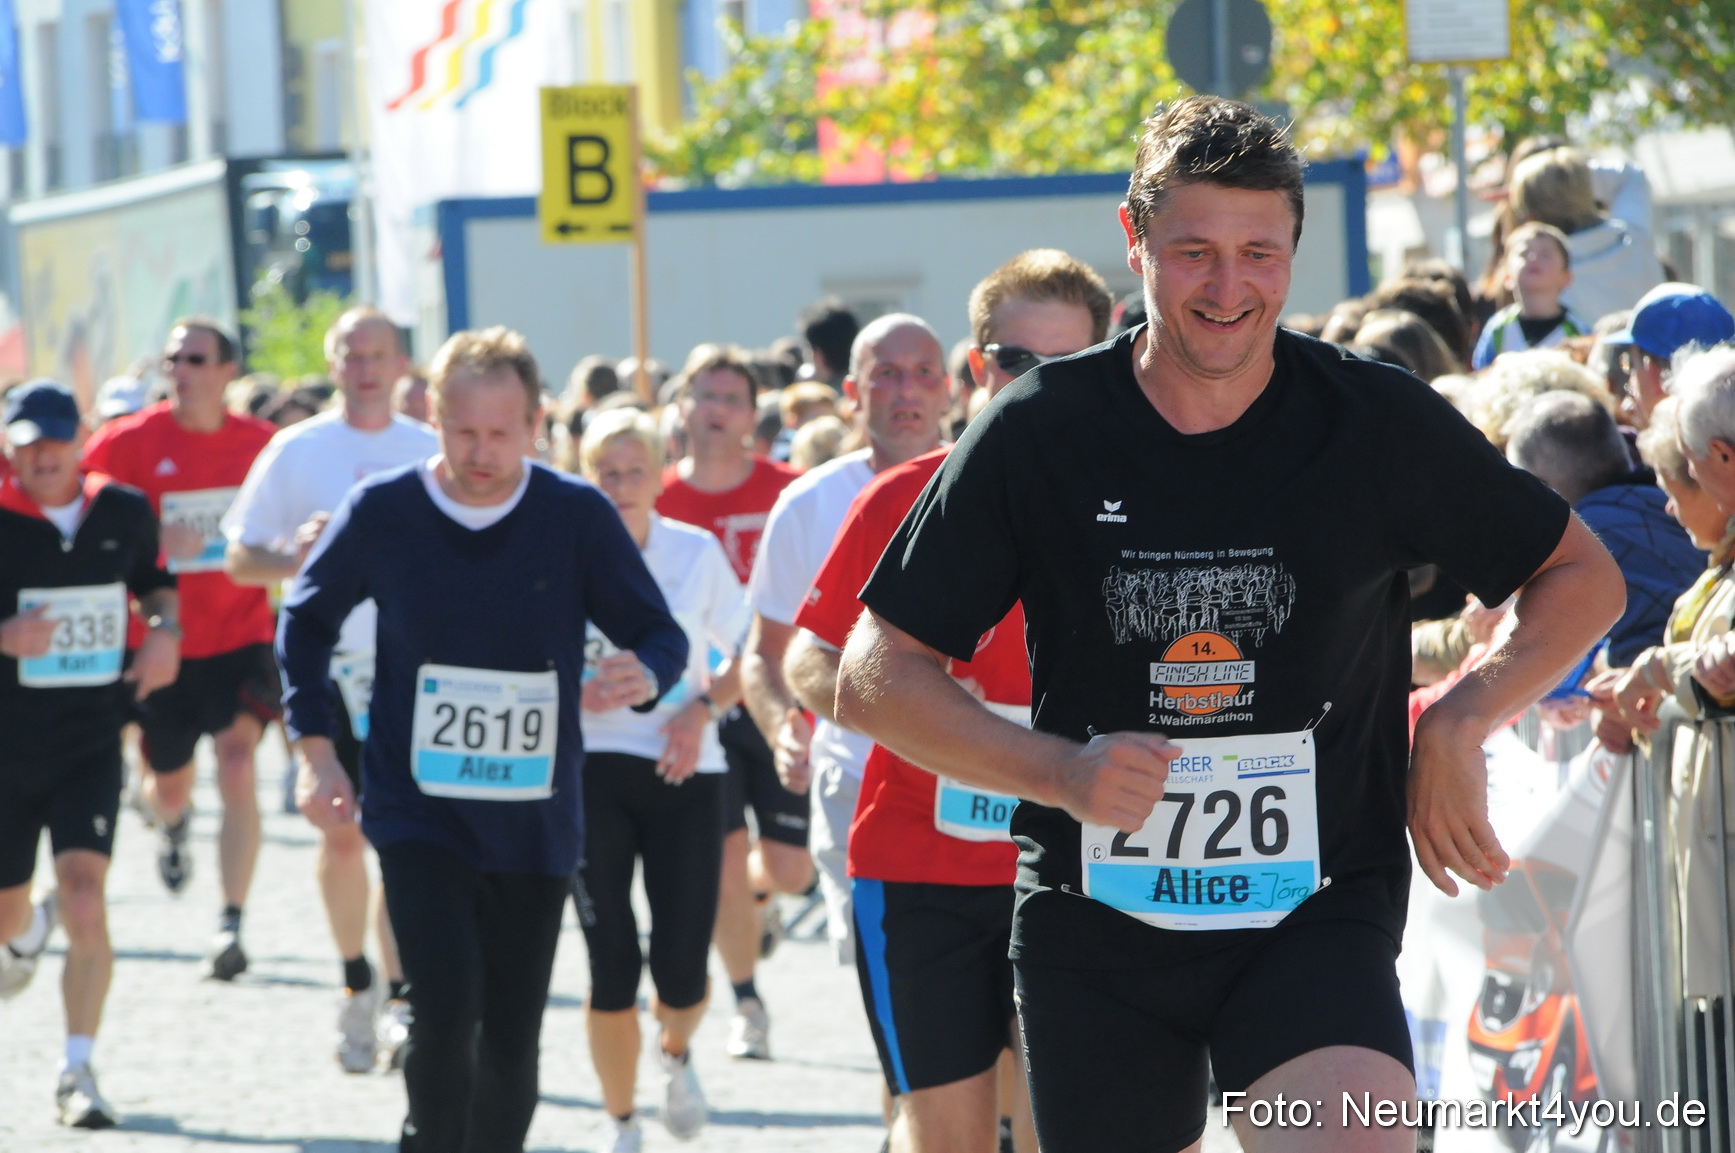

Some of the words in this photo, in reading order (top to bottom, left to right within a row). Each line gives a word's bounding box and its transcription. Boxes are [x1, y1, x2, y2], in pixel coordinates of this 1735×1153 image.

[568, 135, 615, 205] B
[1096, 512, 1128, 523] erima
[1121, 549, 1136, 559] Wir
[1138, 549, 1172, 561] bringen
[1174, 550, 1214, 561] Nürnberg
[1216, 550, 1226, 558] in
[1228, 547, 1274, 558] Bewegung
[56, 613, 117, 650] 338
[1191, 641, 1216, 656] 14.
[1154, 664, 1208, 683] FINISH
[1212, 663, 1252, 681] LINE
[1150, 690, 1255, 711] Herbstlauf
[432, 702, 543, 752] 2619
[1148, 712, 1254, 727] 2.Waldmarathon
[458, 755, 514, 781] Alex
[1170, 756, 1213, 773] ERER
[1237, 755, 1296, 772] BOCK
[1165, 774, 1214, 785] ELLSCHAFT
[1152, 868, 1250, 905] Alice
